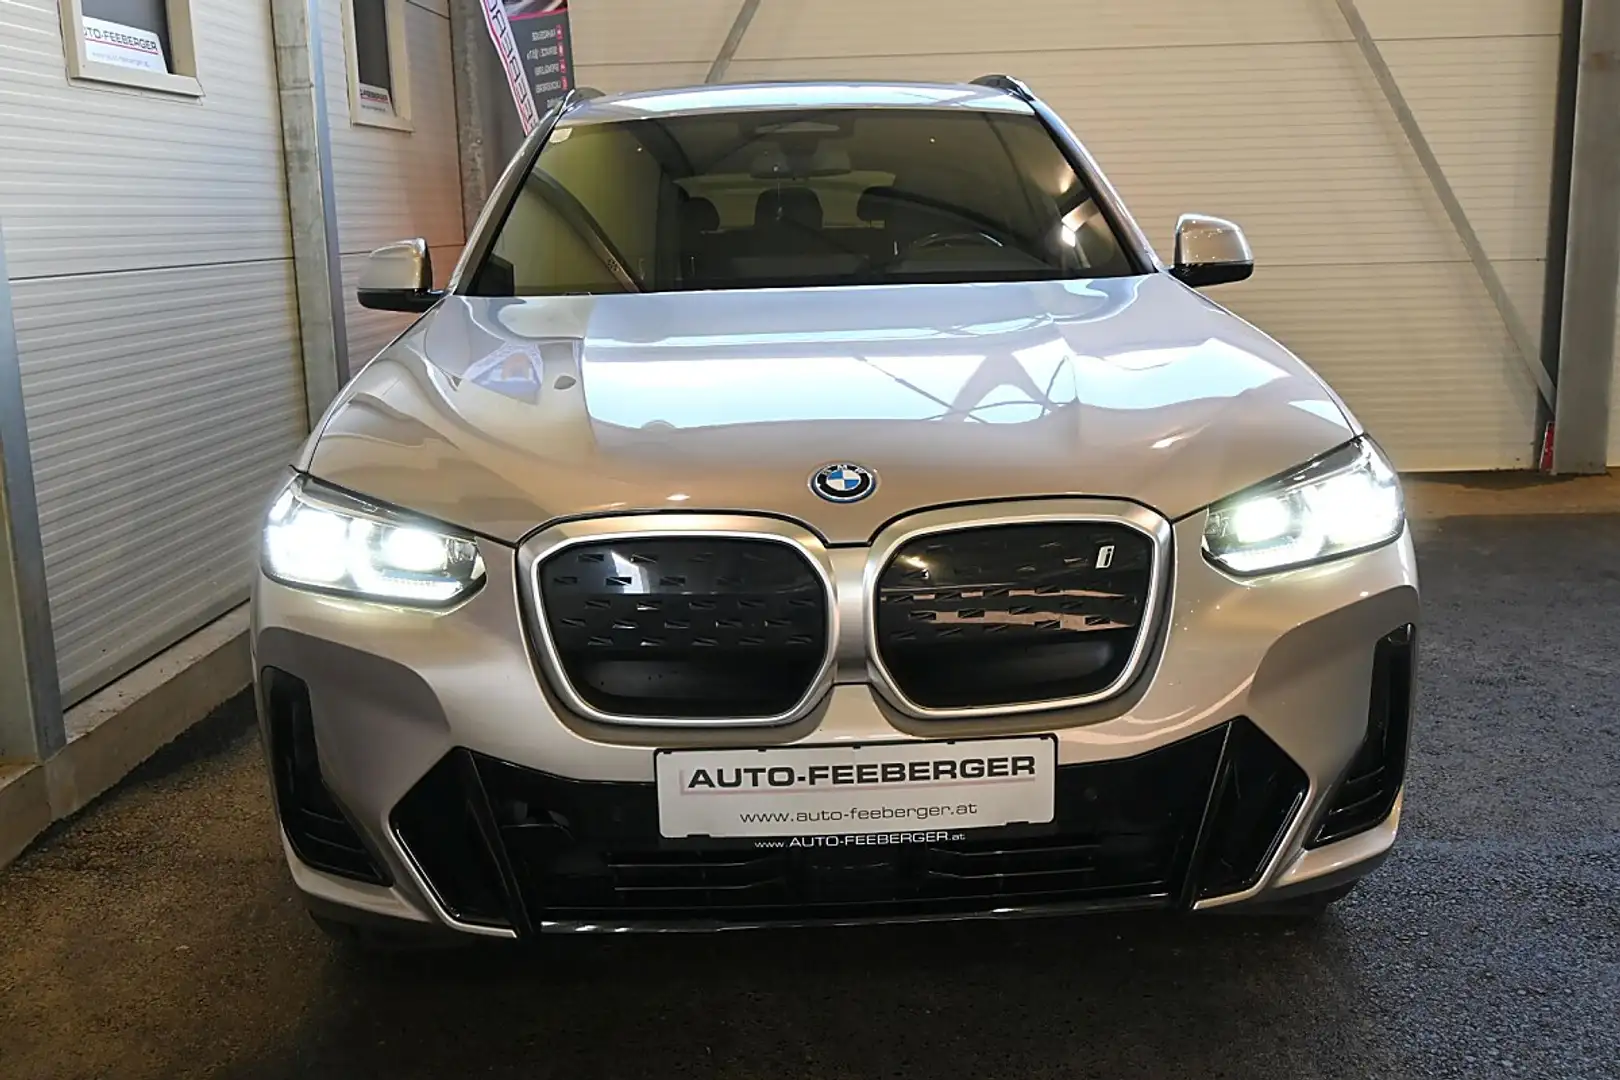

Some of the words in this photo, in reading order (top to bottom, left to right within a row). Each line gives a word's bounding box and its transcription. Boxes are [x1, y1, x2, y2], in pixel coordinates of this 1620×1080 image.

[688, 756, 1035, 788] AUTO-FEEBERGER
[740, 803, 977, 823] www.auto-feeberger.at
[754, 831, 966, 848] www.AUTO-FEEBERGER.at
